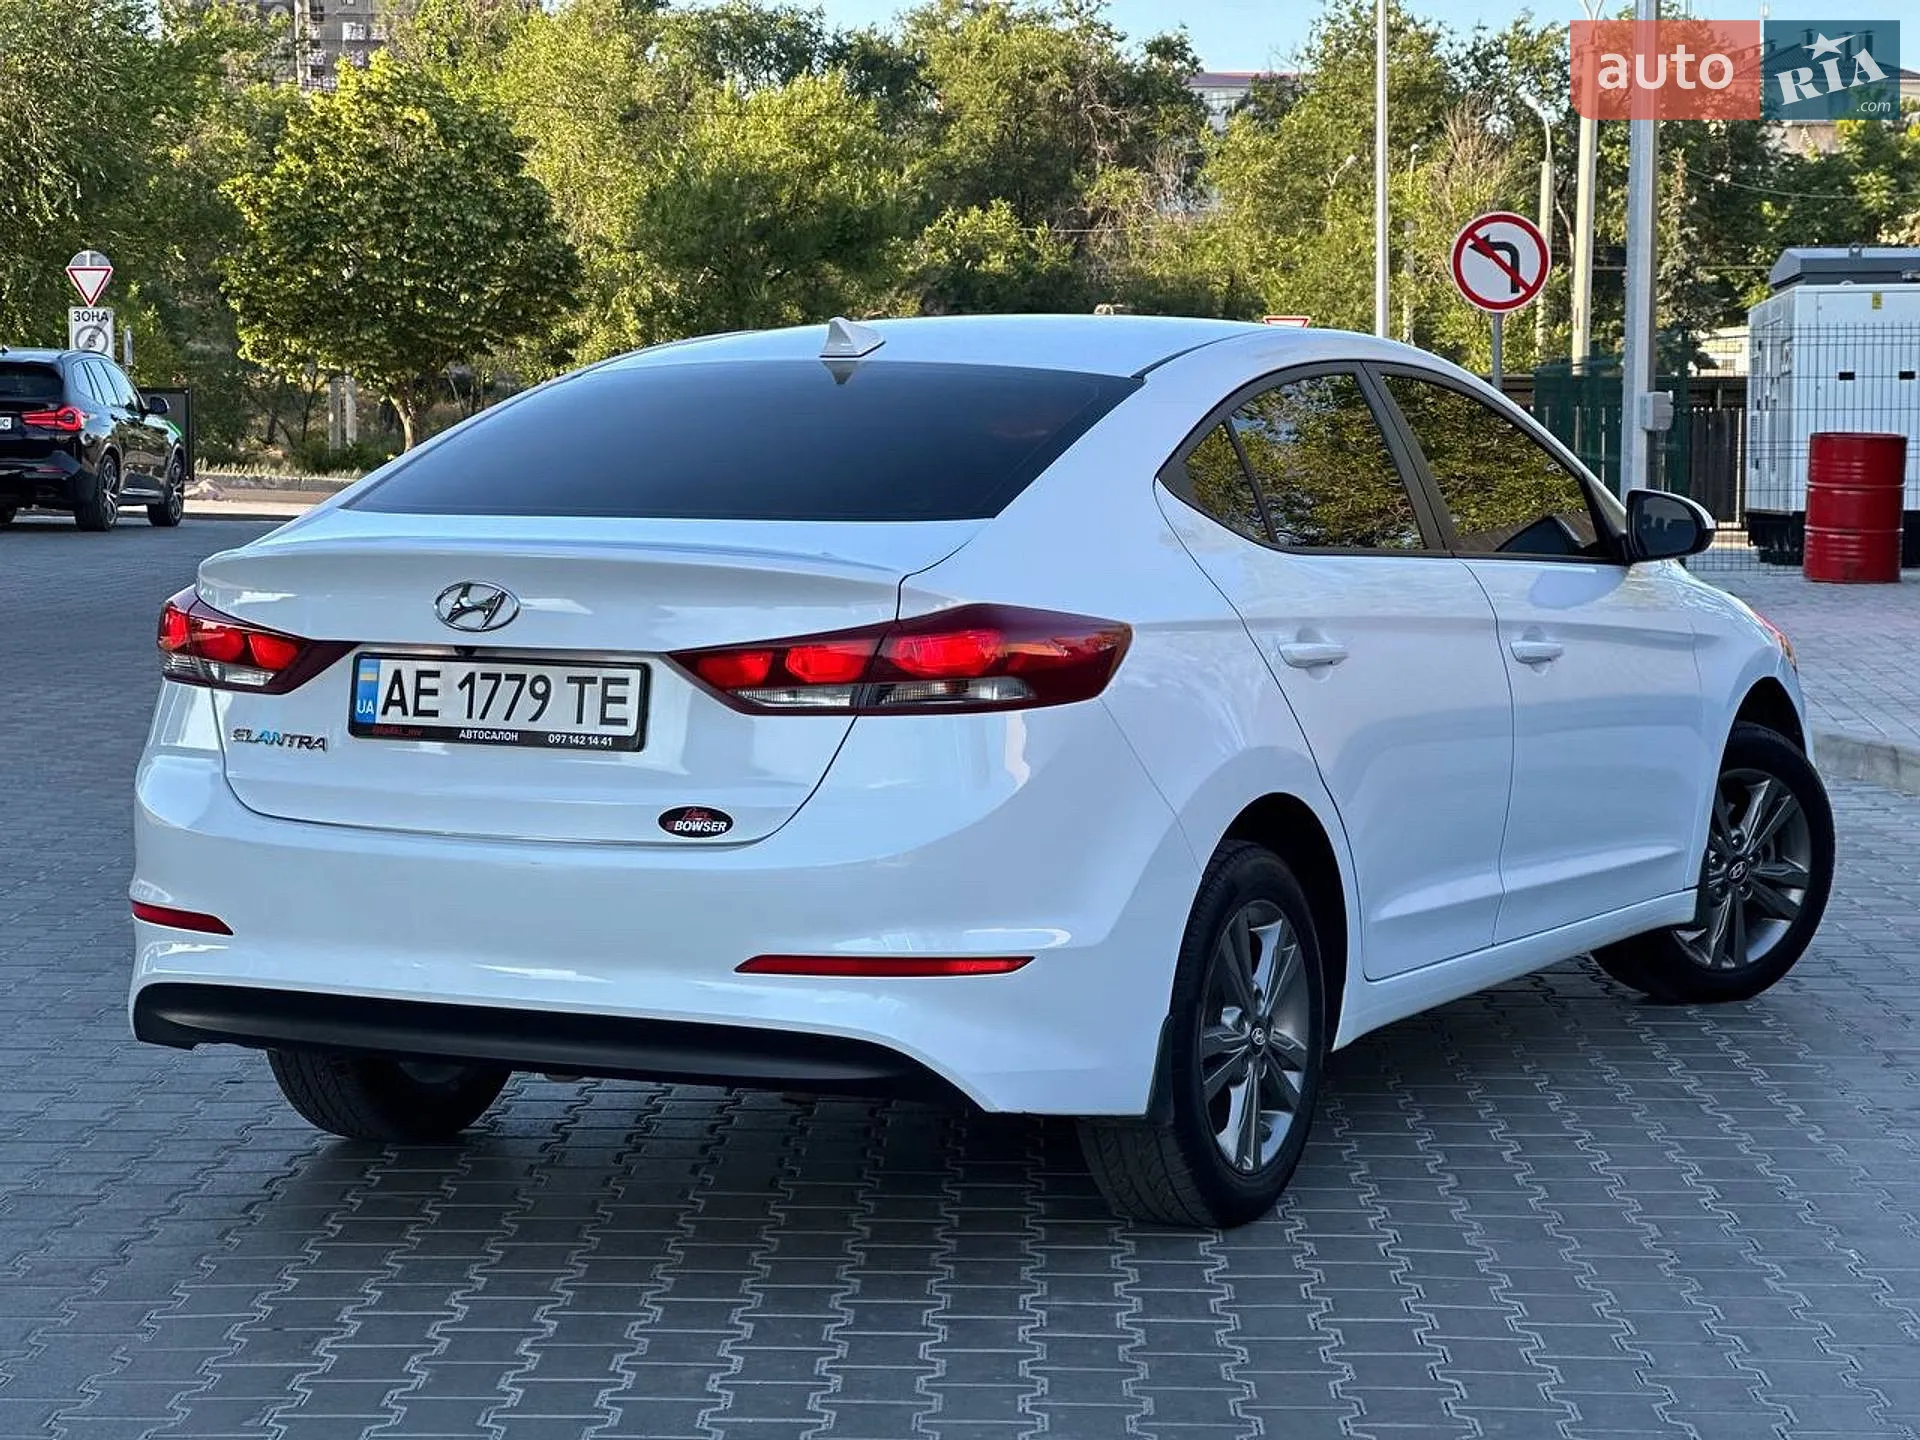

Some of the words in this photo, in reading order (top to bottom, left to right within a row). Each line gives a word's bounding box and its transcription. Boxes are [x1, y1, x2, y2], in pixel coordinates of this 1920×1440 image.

[73, 310, 109, 322] ЗОНА
[381, 668, 441, 717] AE
[457, 671, 552, 722] 1779
[566, 675, 631, 727] TE
[356, 699, 375, 715] UA
[232, 728, 328, 751] ELANTRA
[459, 729, 519, 742] АВТОСАЛОН
[548, 733, 566, 744] 097
[569, 735, 586, 745] 142
[588, 736, 599, 745] 14
[600, 737, 613, 746] 41
[674, 820, 727, 832] BOWSER
